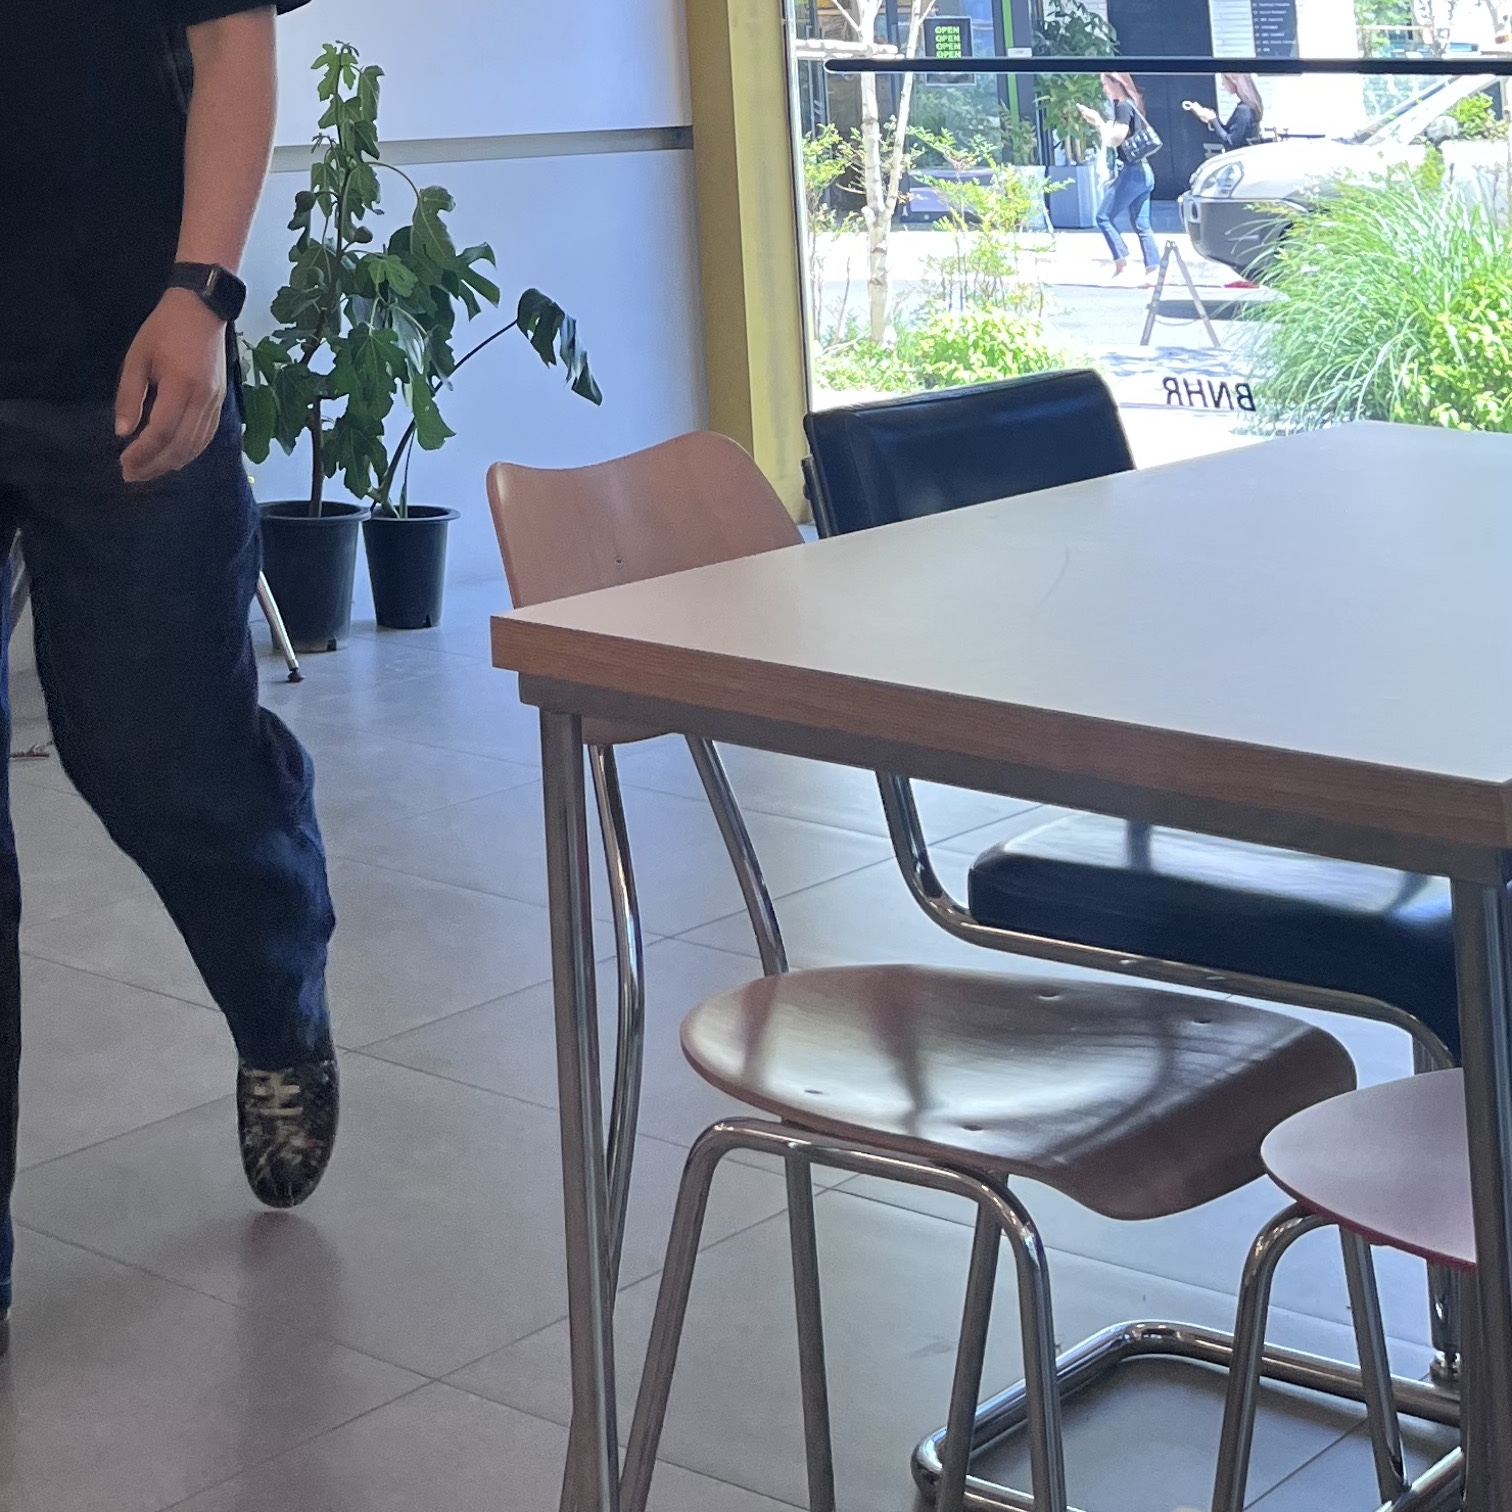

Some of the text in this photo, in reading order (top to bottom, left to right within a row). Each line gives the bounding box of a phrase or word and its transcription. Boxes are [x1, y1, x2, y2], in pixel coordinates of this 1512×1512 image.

[935, 26, 960, 34] OPEN
[935, 34, 960, 42] OPEN
[936, 42, 961, 50] OPEN
[936, 50, 962, 58] OPEN
